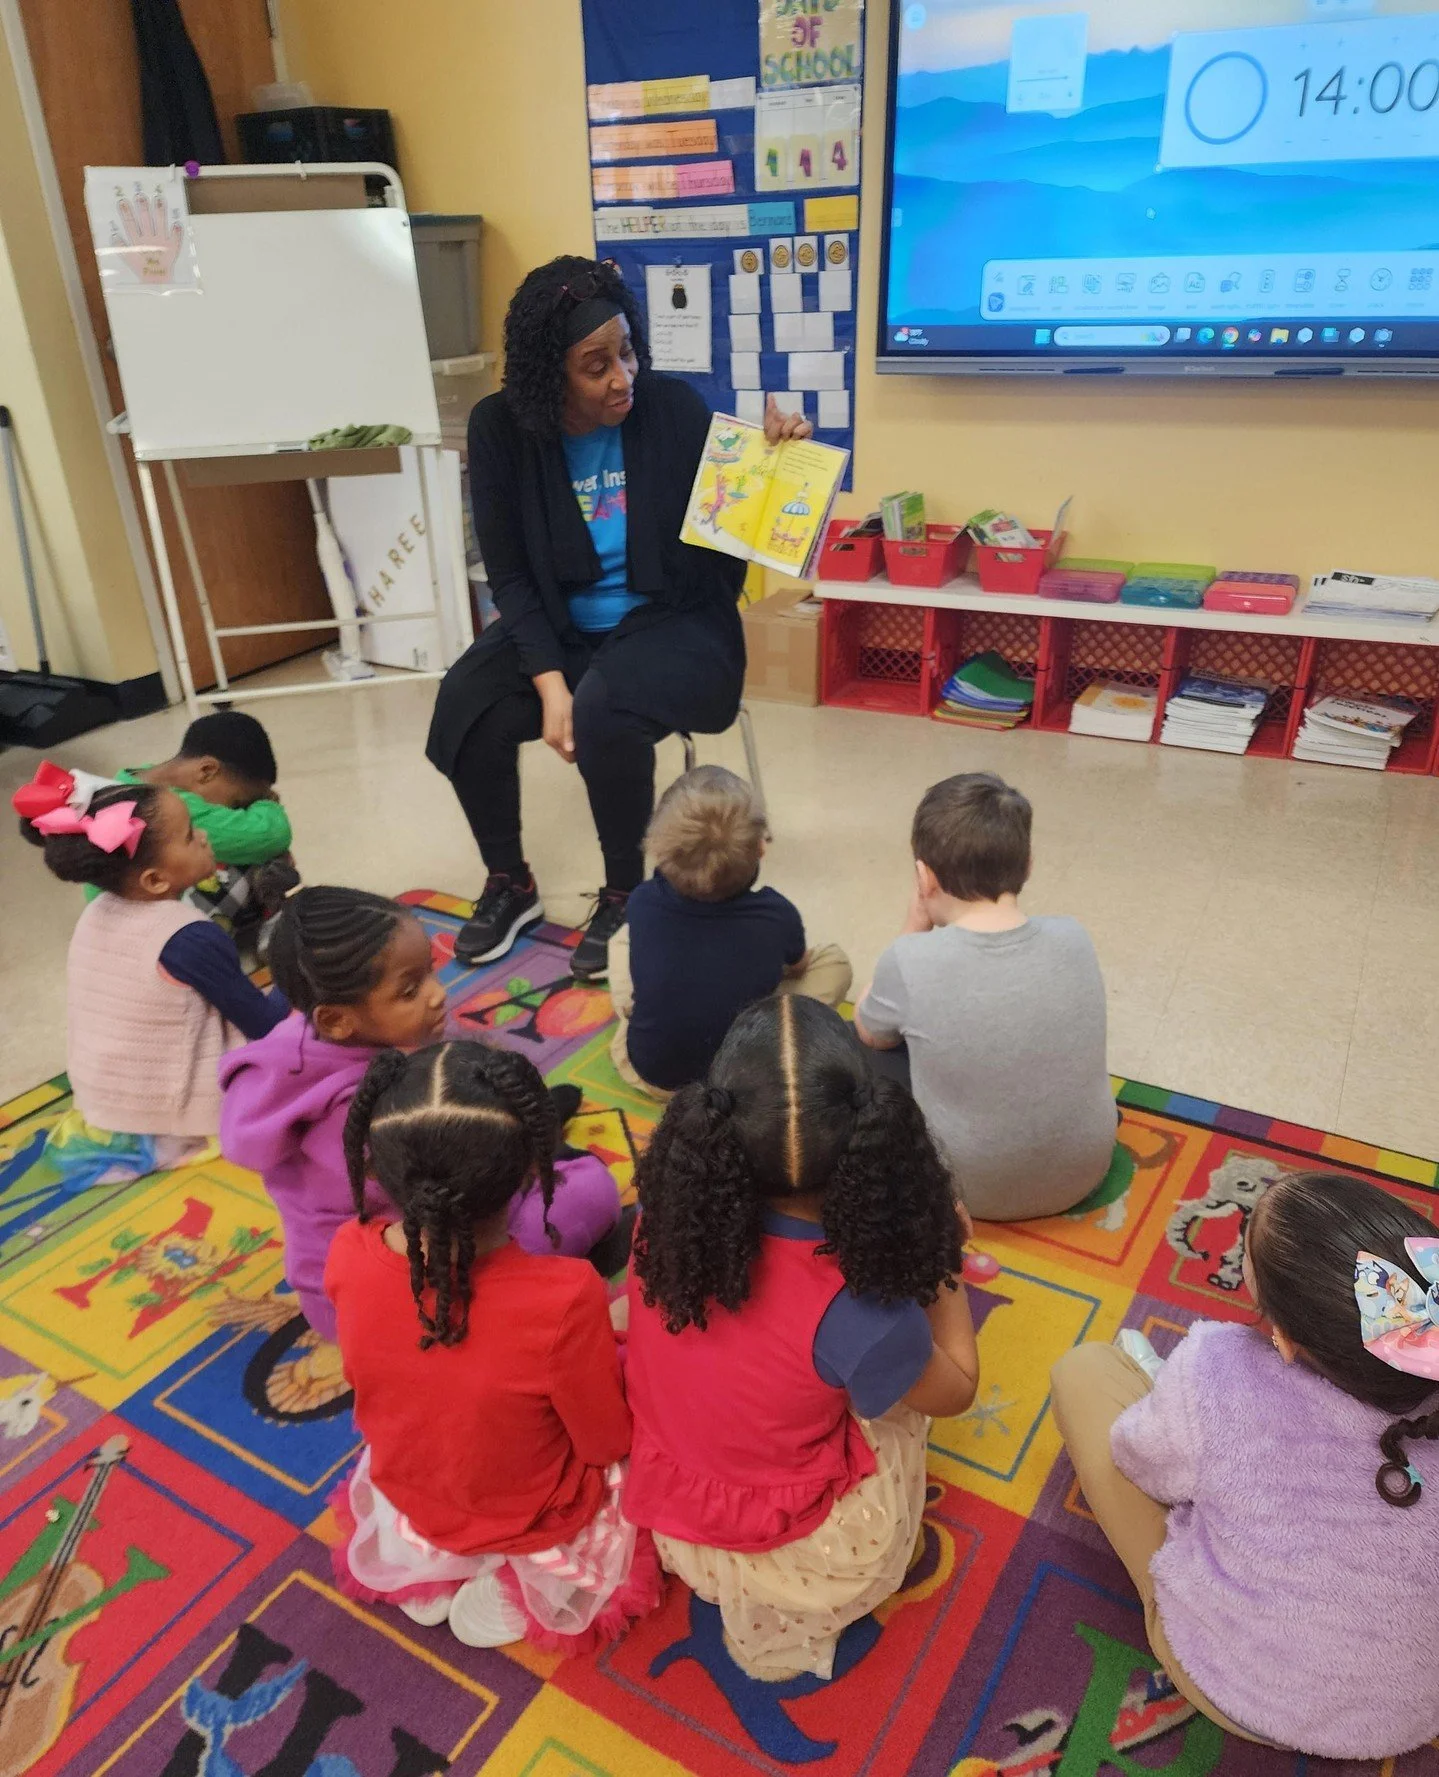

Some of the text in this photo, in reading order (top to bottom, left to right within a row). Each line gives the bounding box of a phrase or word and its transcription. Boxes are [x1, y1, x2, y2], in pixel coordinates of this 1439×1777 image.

[791, 15, 823, 48] OF
[764, 44, 857, 84] SCHOOL
[1294, 58, 1439, 117] 14:00
[620, 215, 665, 233] HELPER
